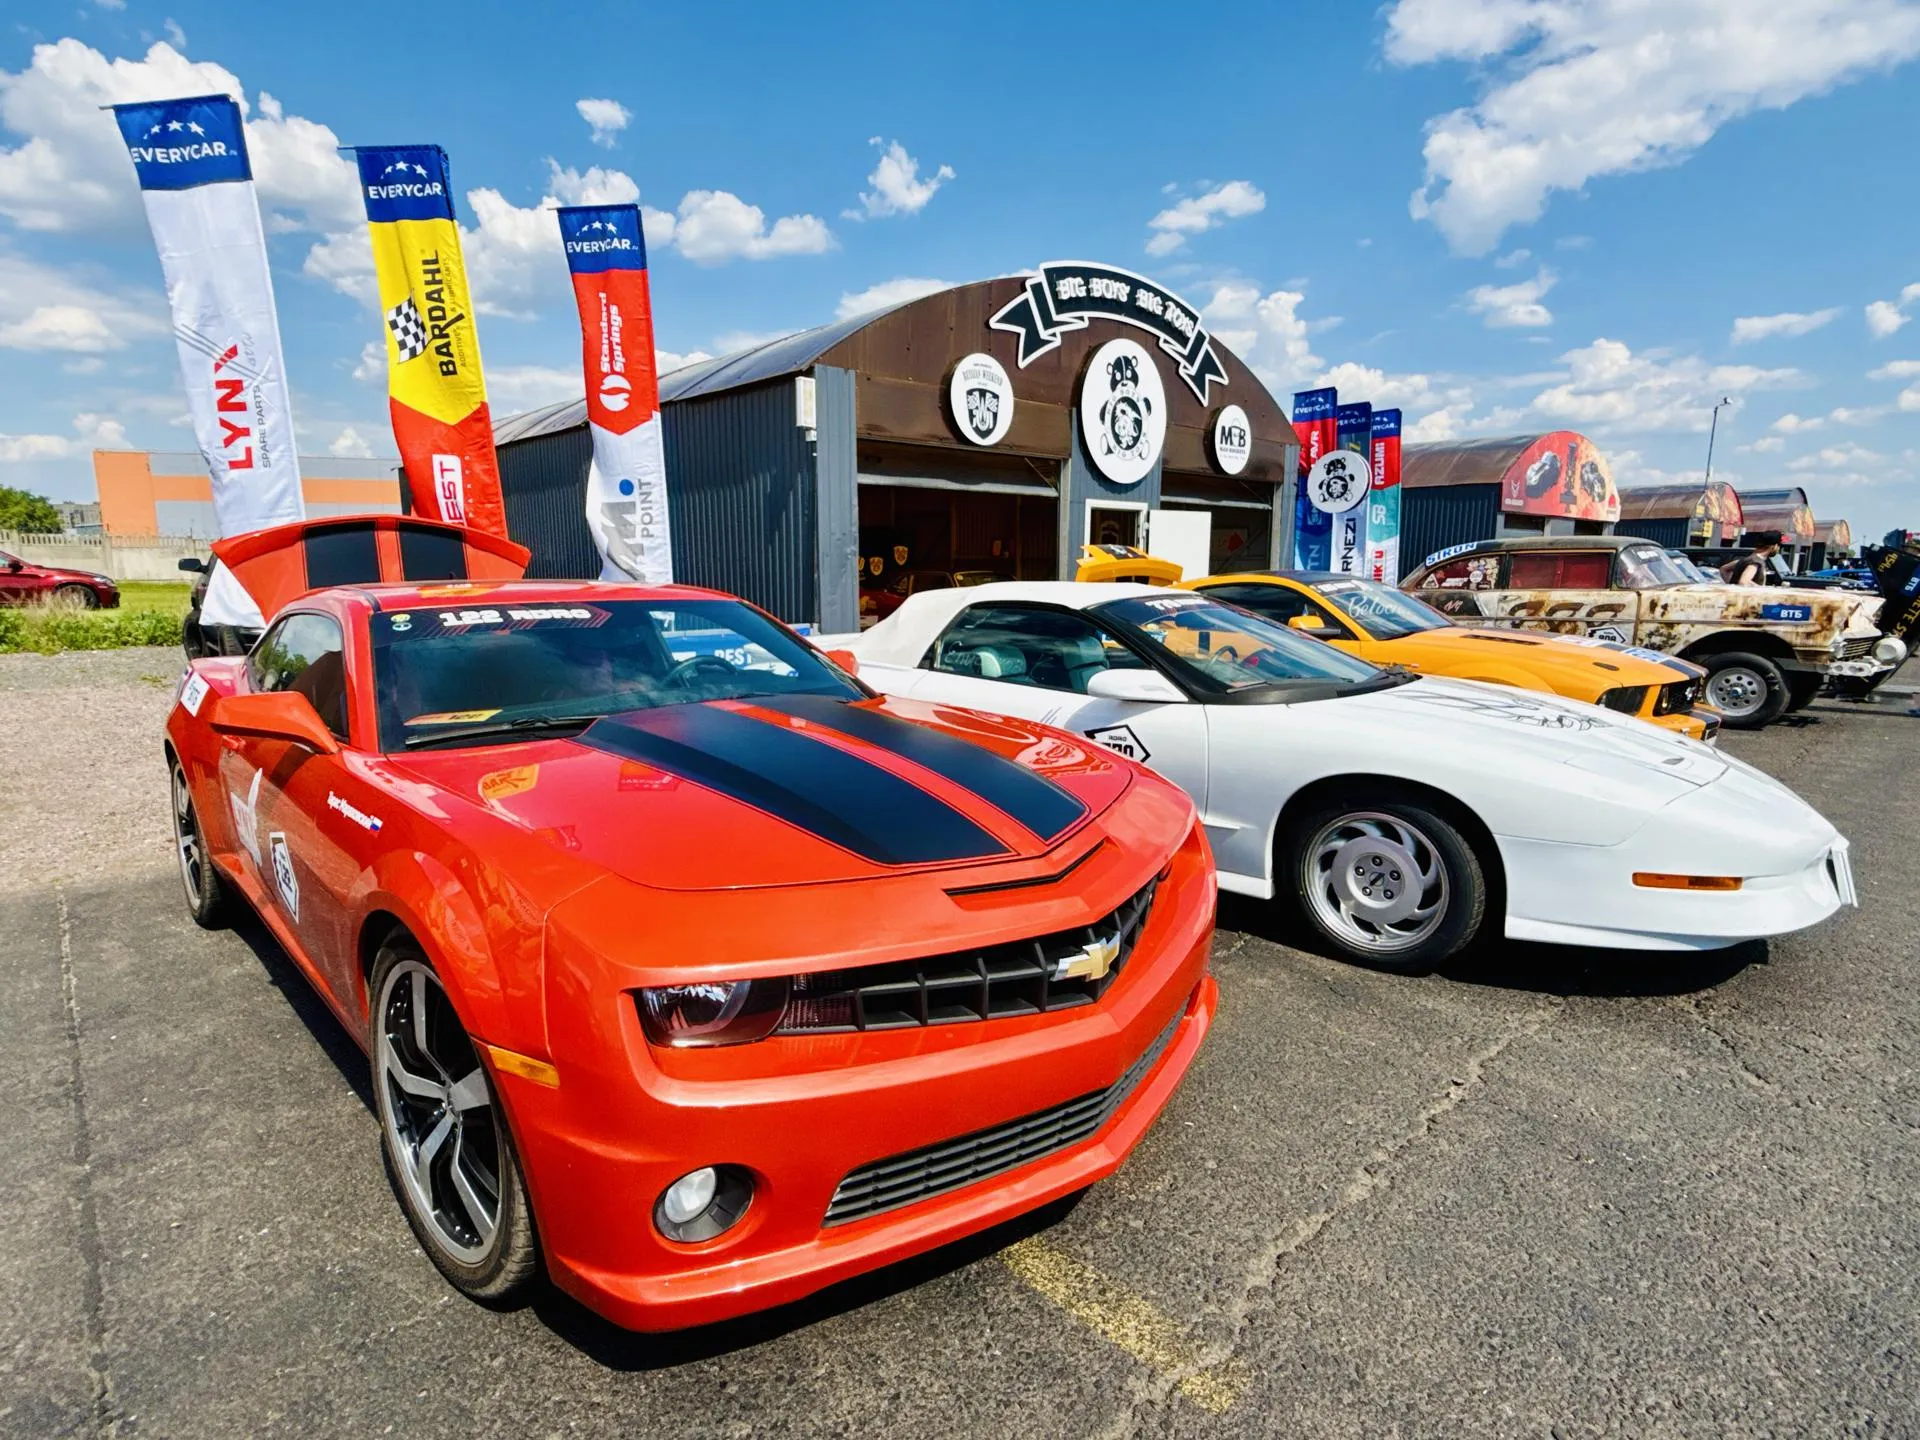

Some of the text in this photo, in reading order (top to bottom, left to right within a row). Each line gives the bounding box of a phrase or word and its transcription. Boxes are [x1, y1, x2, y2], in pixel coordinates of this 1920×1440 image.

[131, 141, 227, 164] EVERYCAR
[368, 182, 442, 200] EVERYCAR
[567, 239, 631, 253] EVERYCAR
[422, 249, 464, 377] BARDAHL
[1056, 277, 1195, 336] BIG BOYS BIG TOYS
[599, 292, 611, 374] Standard
[610, 304, 627, 374] Springs
[253, 385, 271, 468] SPARE PARTS
[1295, 403, 1330, 414] EVERYCAR
[1375, 442, 1385, 485] AZUMI
[638, 478, 654, 538] POINT
[439, 610, 504, 627] 122
[1780, 609, 1802, 618] ВТБ
